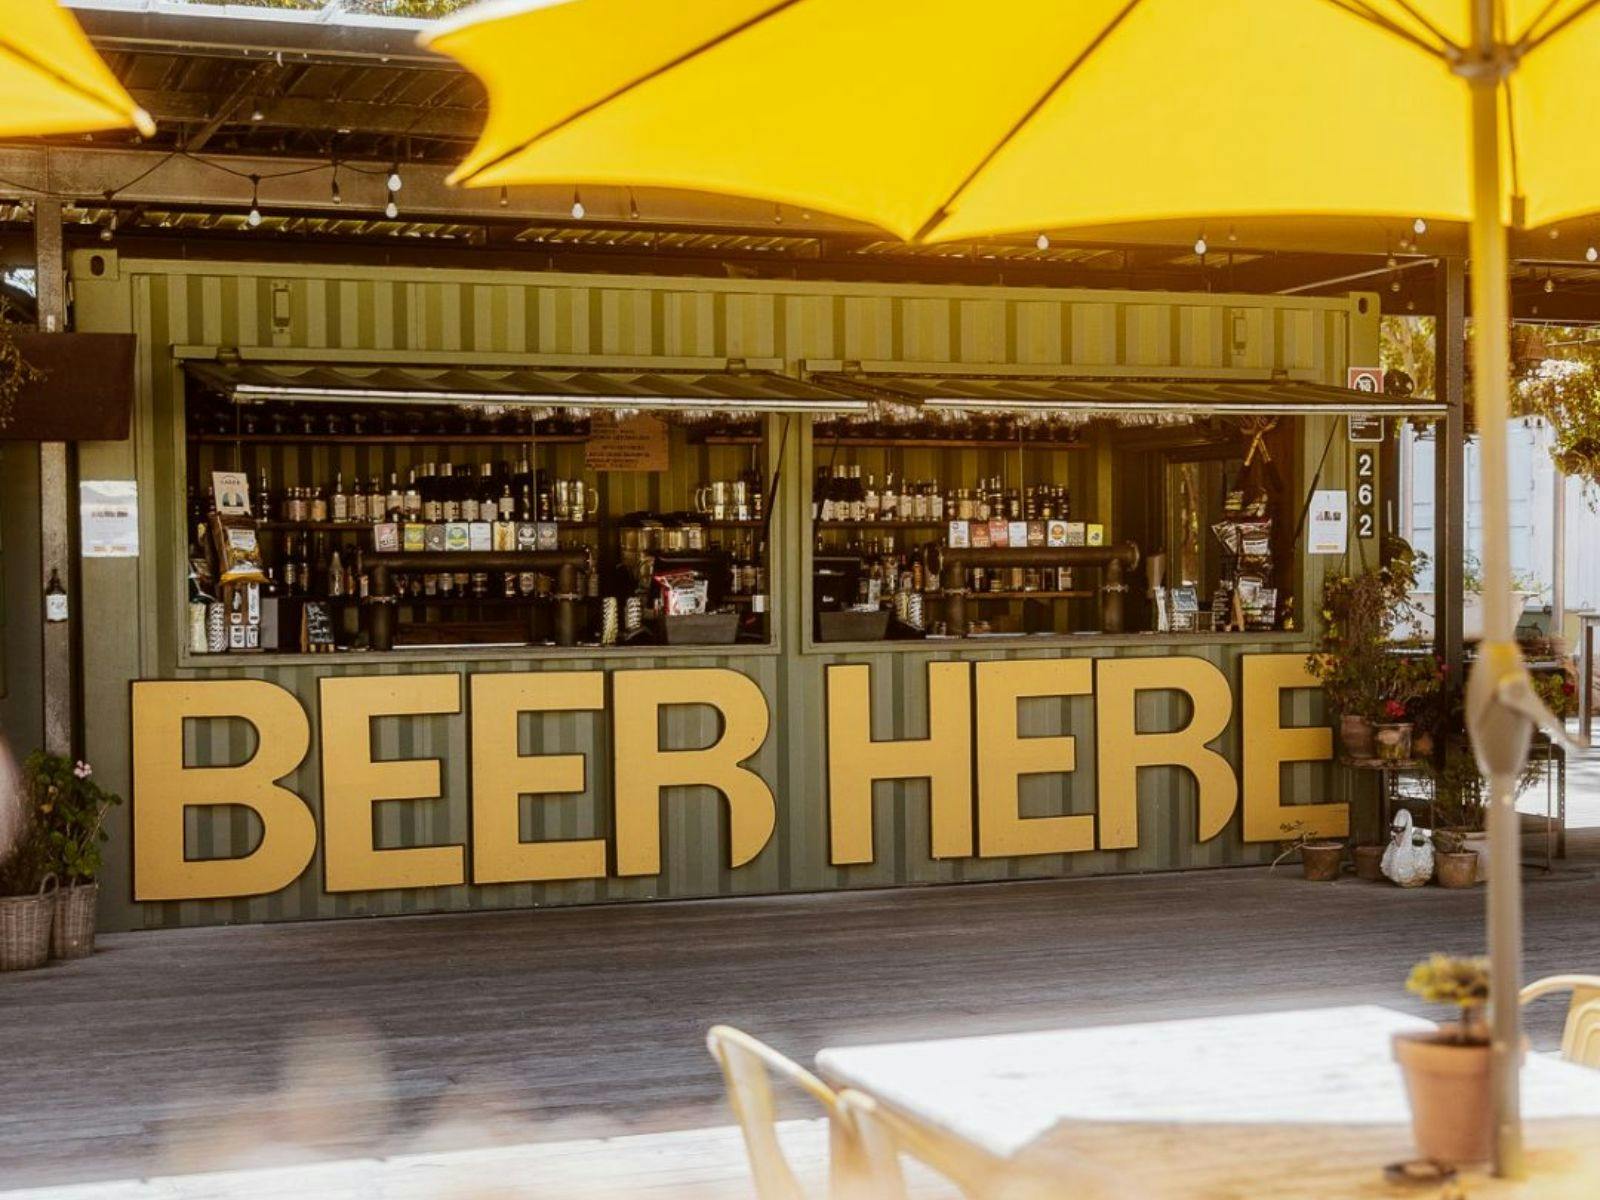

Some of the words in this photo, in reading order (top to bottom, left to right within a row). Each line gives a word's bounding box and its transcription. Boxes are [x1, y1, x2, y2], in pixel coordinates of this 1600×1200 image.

[1358, 454, 1372, 536] 262
[130, 667, 776, 901] BEER
[825, 653, 1350, 865] HERE
